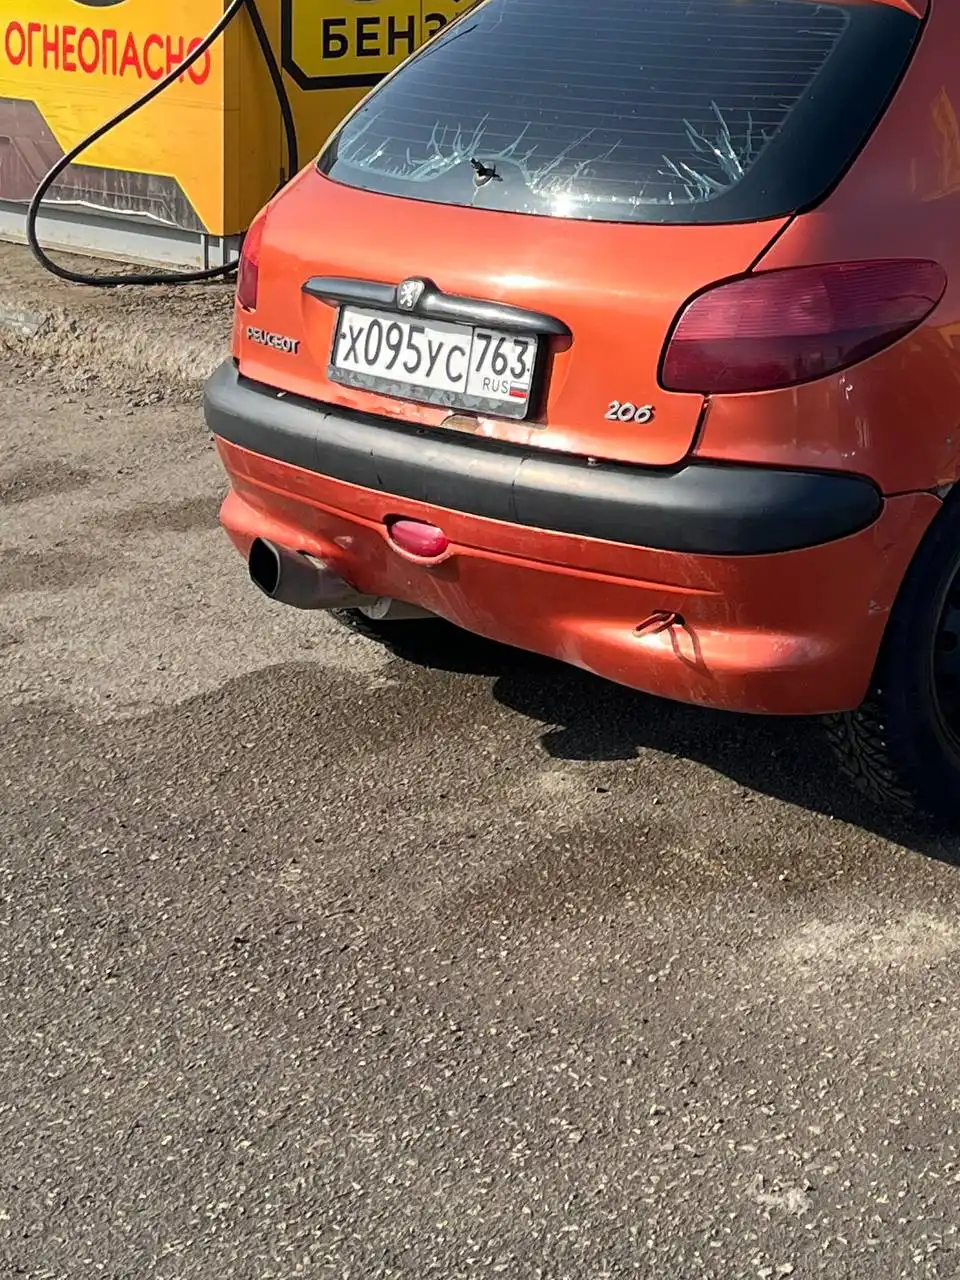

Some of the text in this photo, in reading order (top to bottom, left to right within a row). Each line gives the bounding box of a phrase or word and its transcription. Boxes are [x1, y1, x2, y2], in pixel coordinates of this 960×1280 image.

[5, 20, 211, 86] ОГНЕОПАСНО
[322, 11, 460, 60] БЕНЗ
[248, 327, 300, 355] PEUGEOT
[475, 332, 529, 380] 763
[482, 377, 509, 395] RUS
[604, 400, 656, 424] 206
